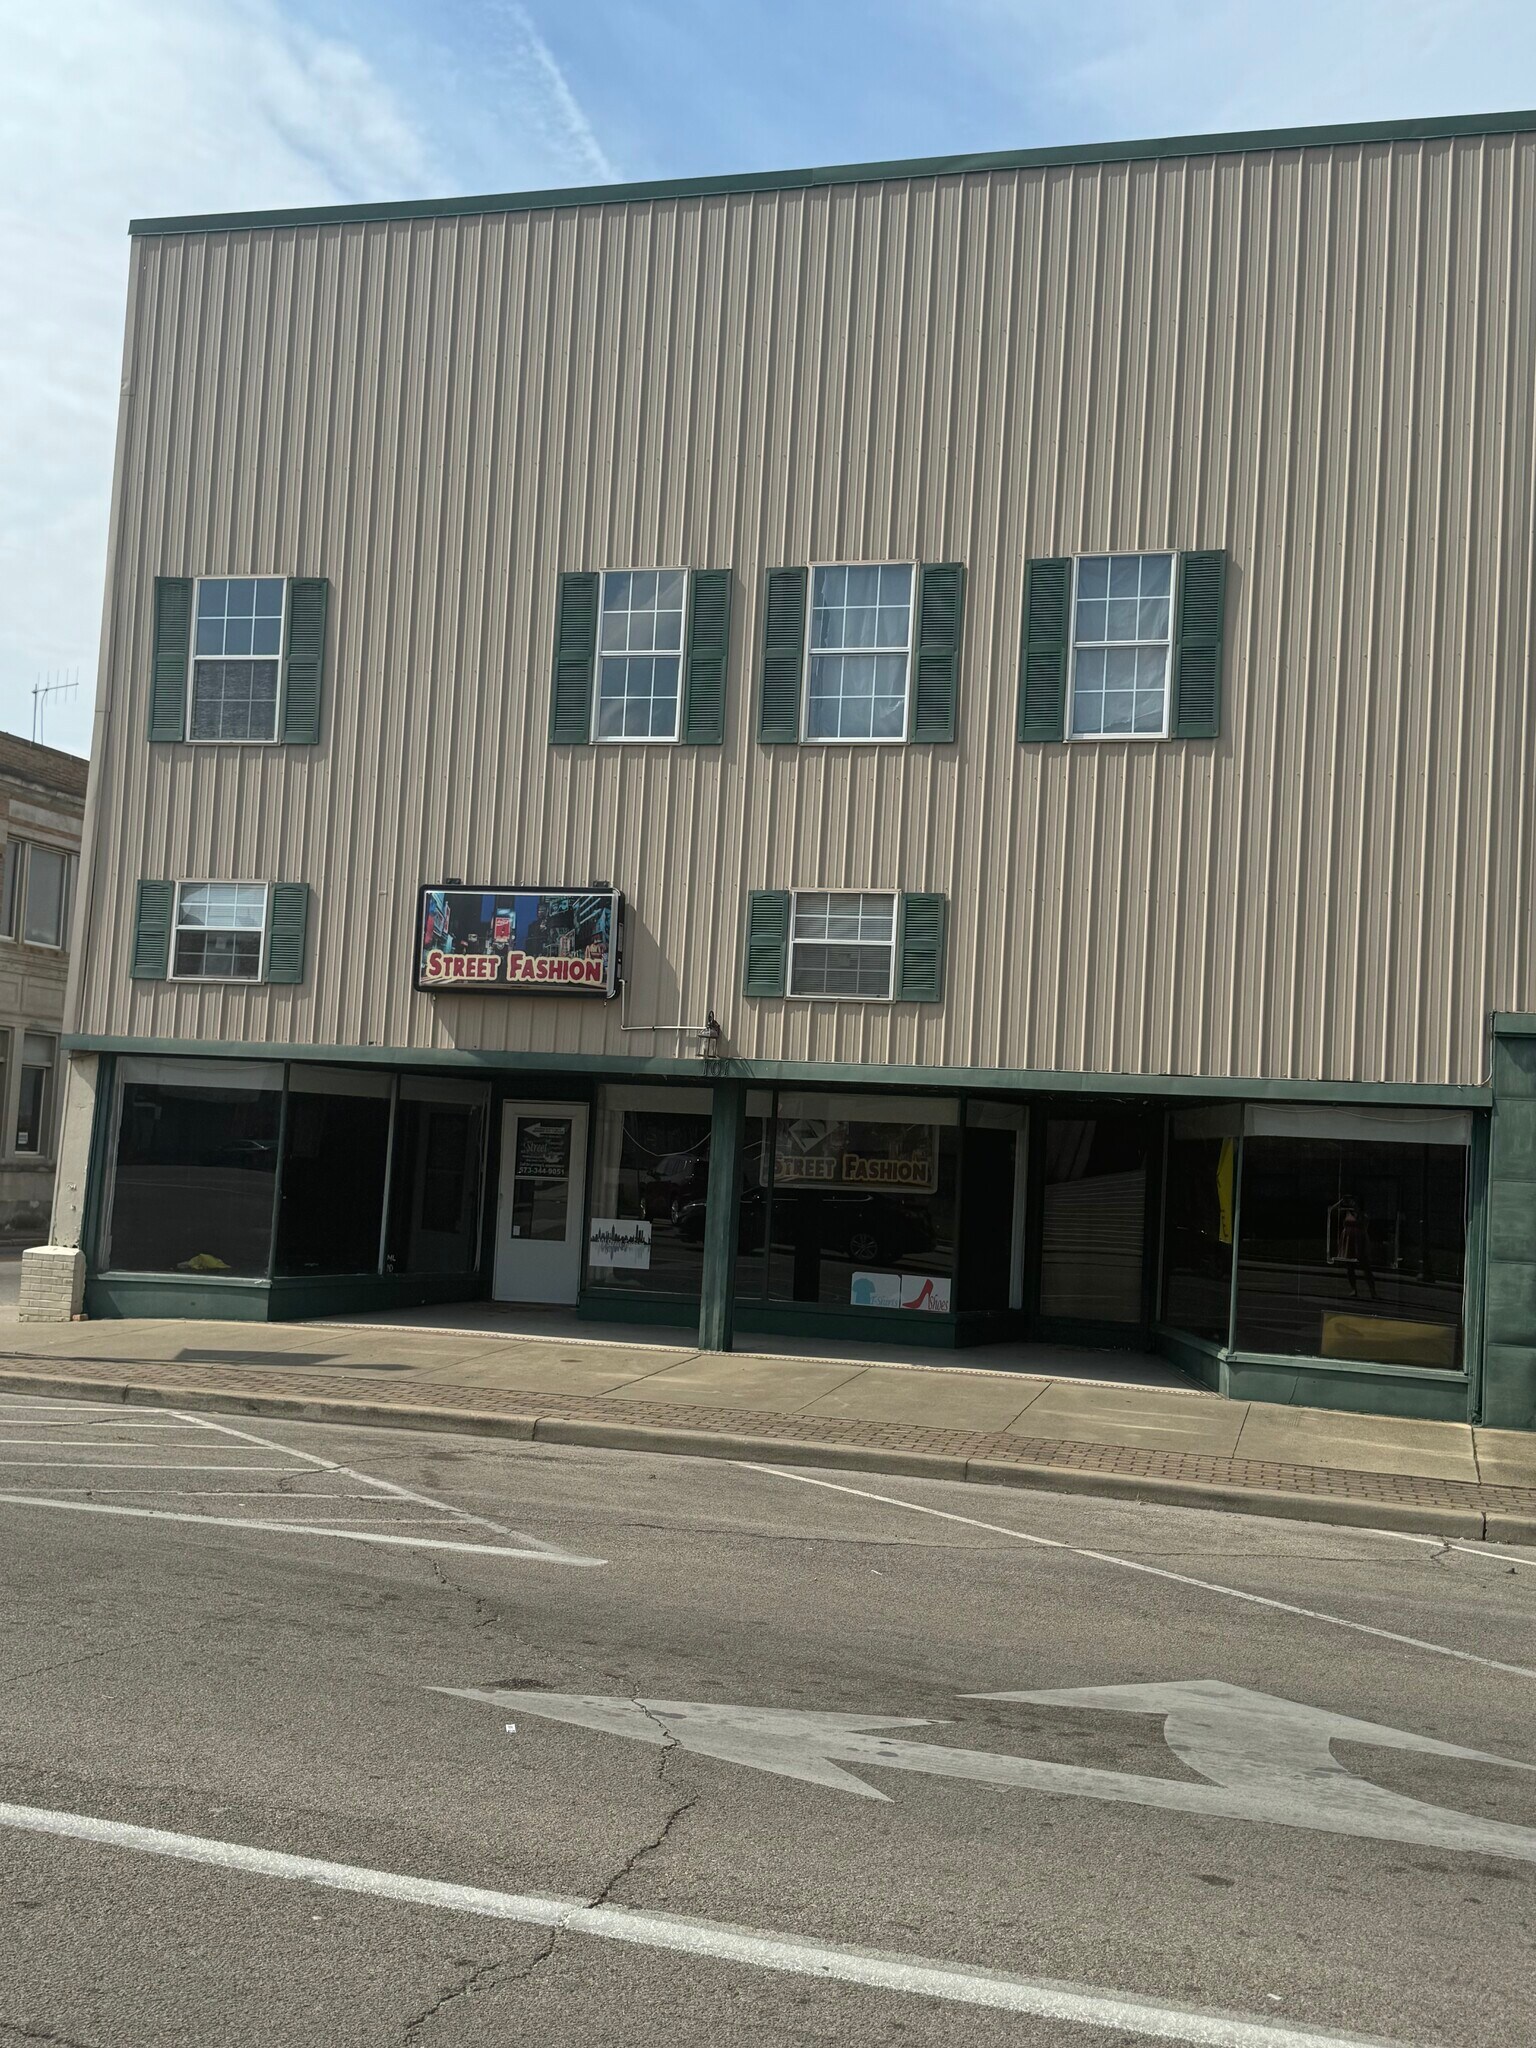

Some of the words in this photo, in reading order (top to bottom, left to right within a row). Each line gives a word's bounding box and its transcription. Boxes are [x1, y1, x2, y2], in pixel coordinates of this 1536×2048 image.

[427, 951, 499, 979] STREET
[509, 952, 602, 982] FASHION
[844, 1155, 927, 1182] FASHION
[928, 1293, 949, 1311] Shoes
